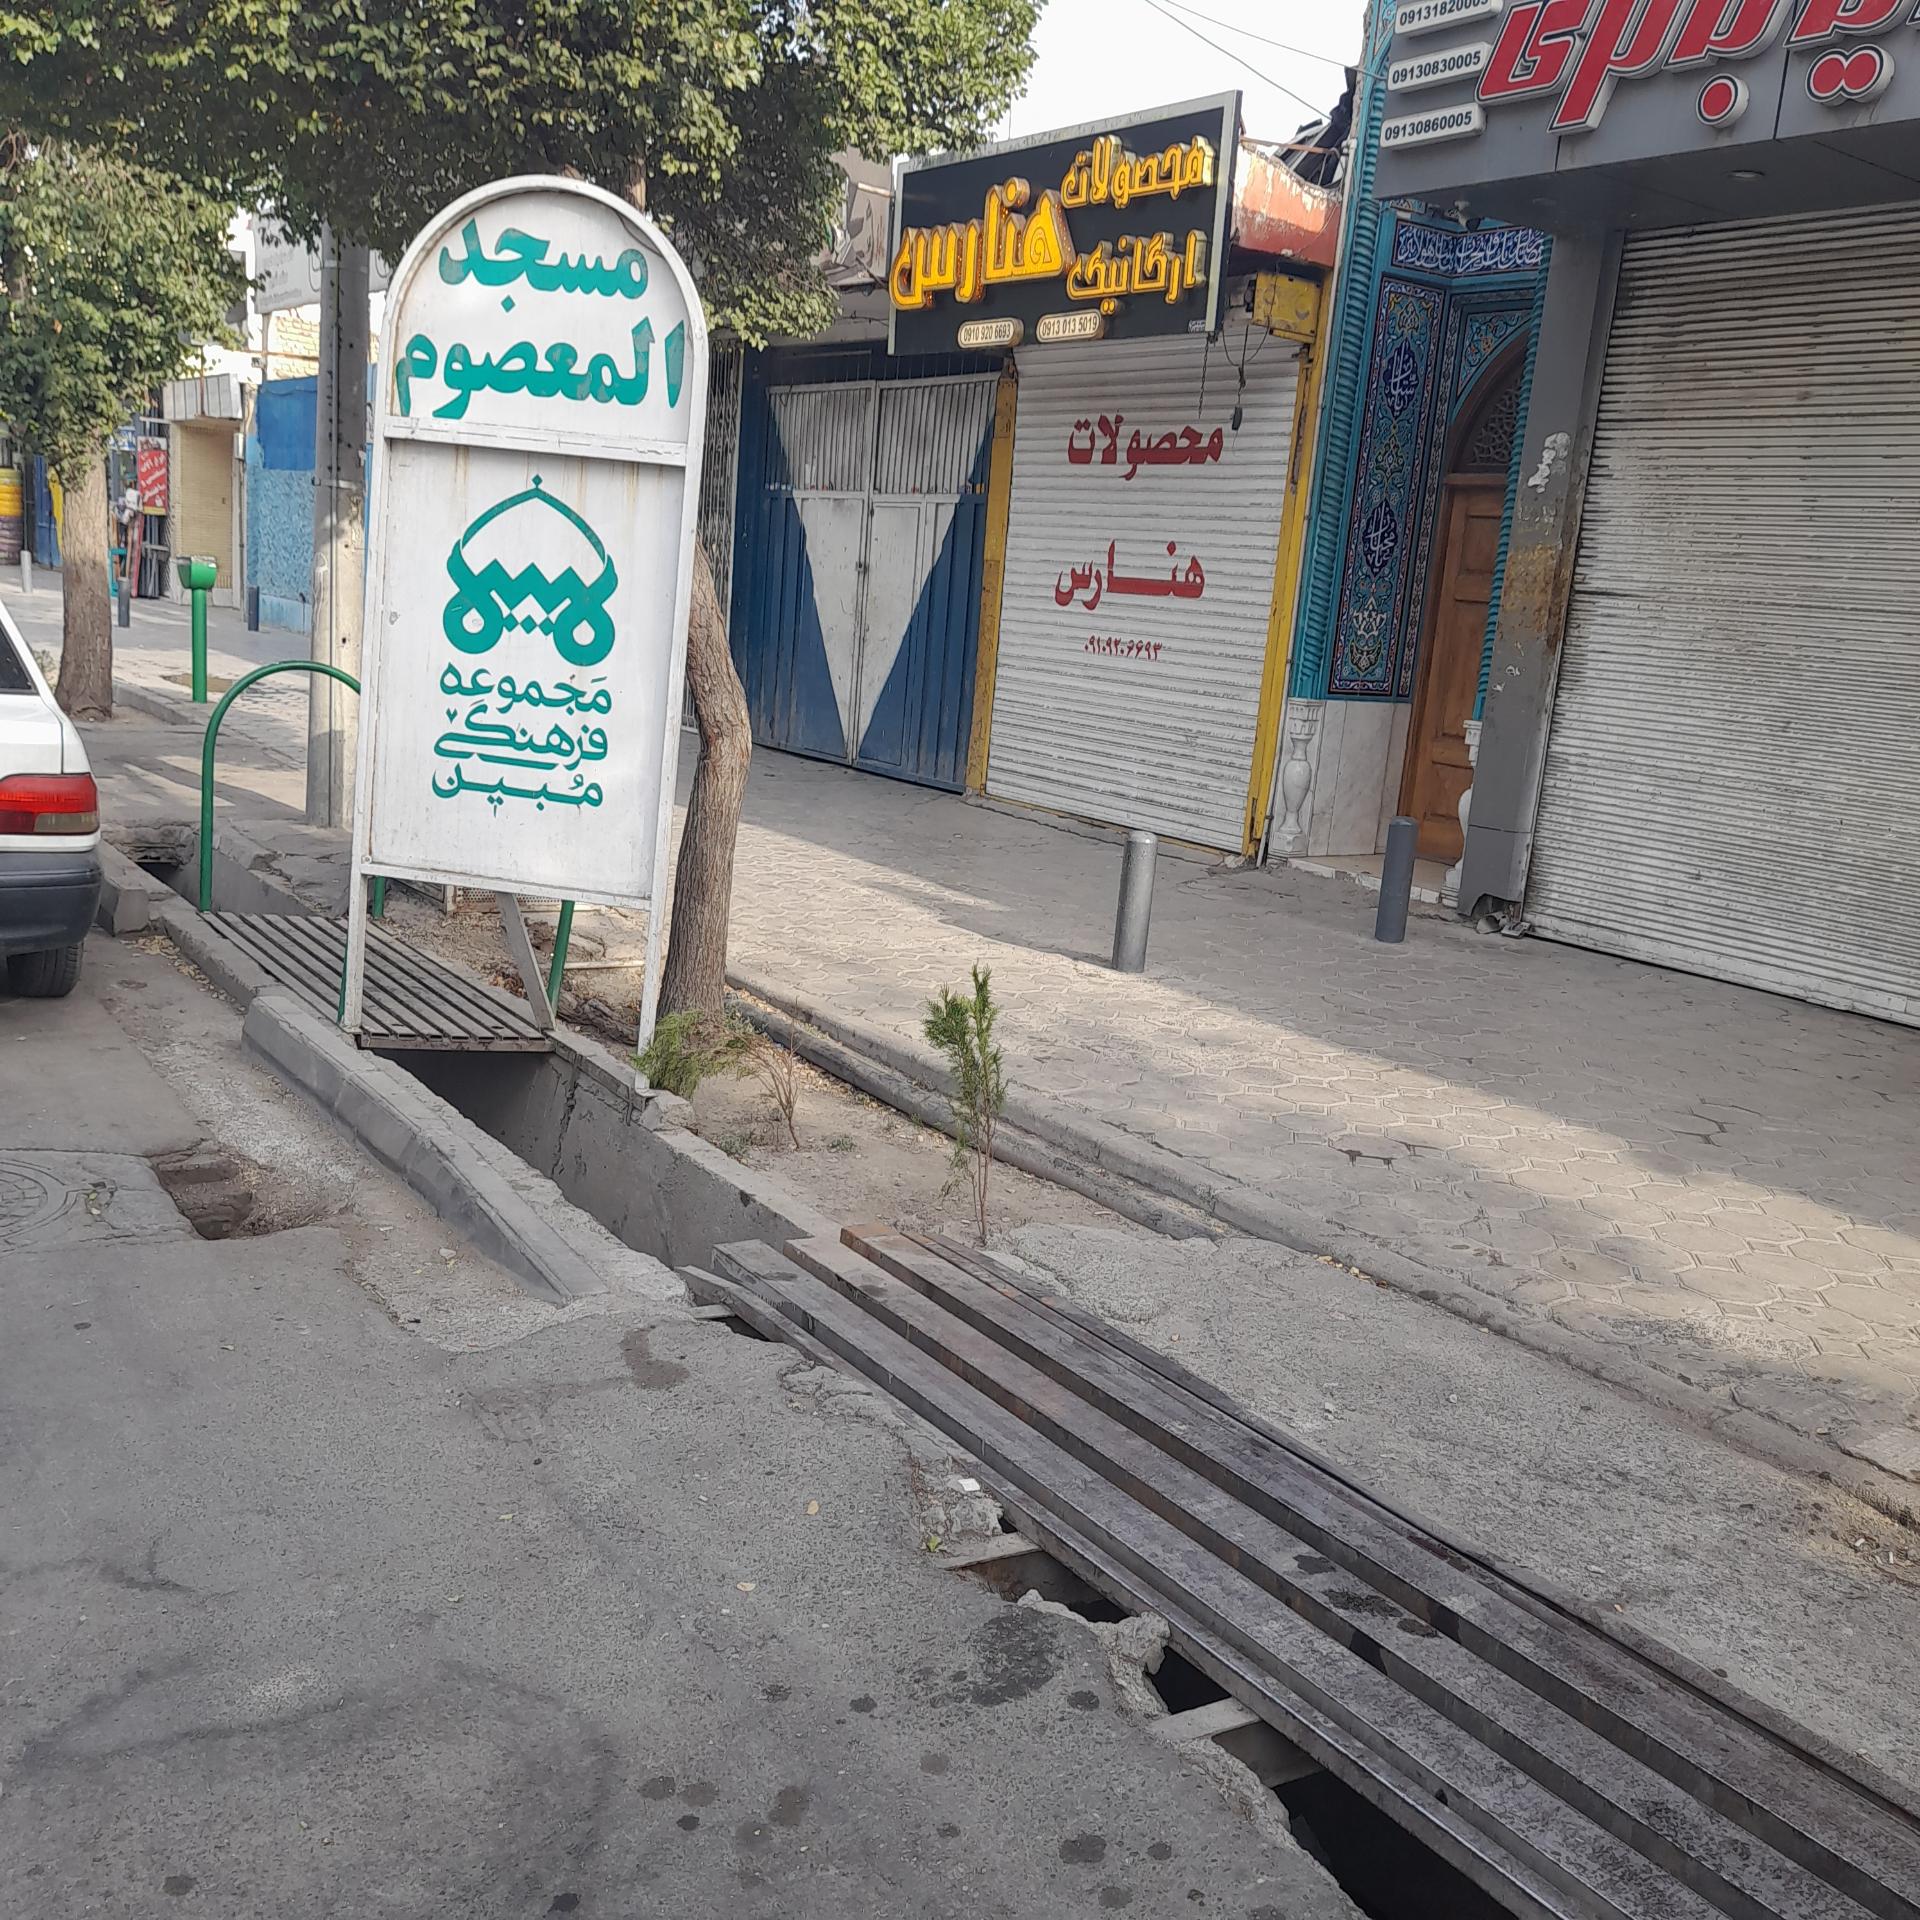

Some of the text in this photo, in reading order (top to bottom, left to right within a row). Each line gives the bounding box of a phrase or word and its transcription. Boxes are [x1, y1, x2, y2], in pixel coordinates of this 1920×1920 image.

[1400, 0, 1488, 26] 091318200
[1392, 50, 1481, 84] 09130830005
[1384, 110, 1472, 141] 09130860005
[1060, 135, 1214, 209] محصولات
[439, 217, 648, 312] مسجد
[889, 178, 1070, 309] هنارس
[1066, 230, 1206, 315] ارگانیک
[963, 323, 1012, 342] 0910 920 6693
[1041, 316, 1098, 336] 0913 013 5019
[396, 316, 685, 419] المعصوم
[1067, 412, 1224, 481] محصولات
[1054, 539, 1206, 611] هنارس
[1085, 635, 1163, 662] ۰۹۱۰۹۲۰۶۶۹۳
[434, 699, 608, 771] فرهنگی
